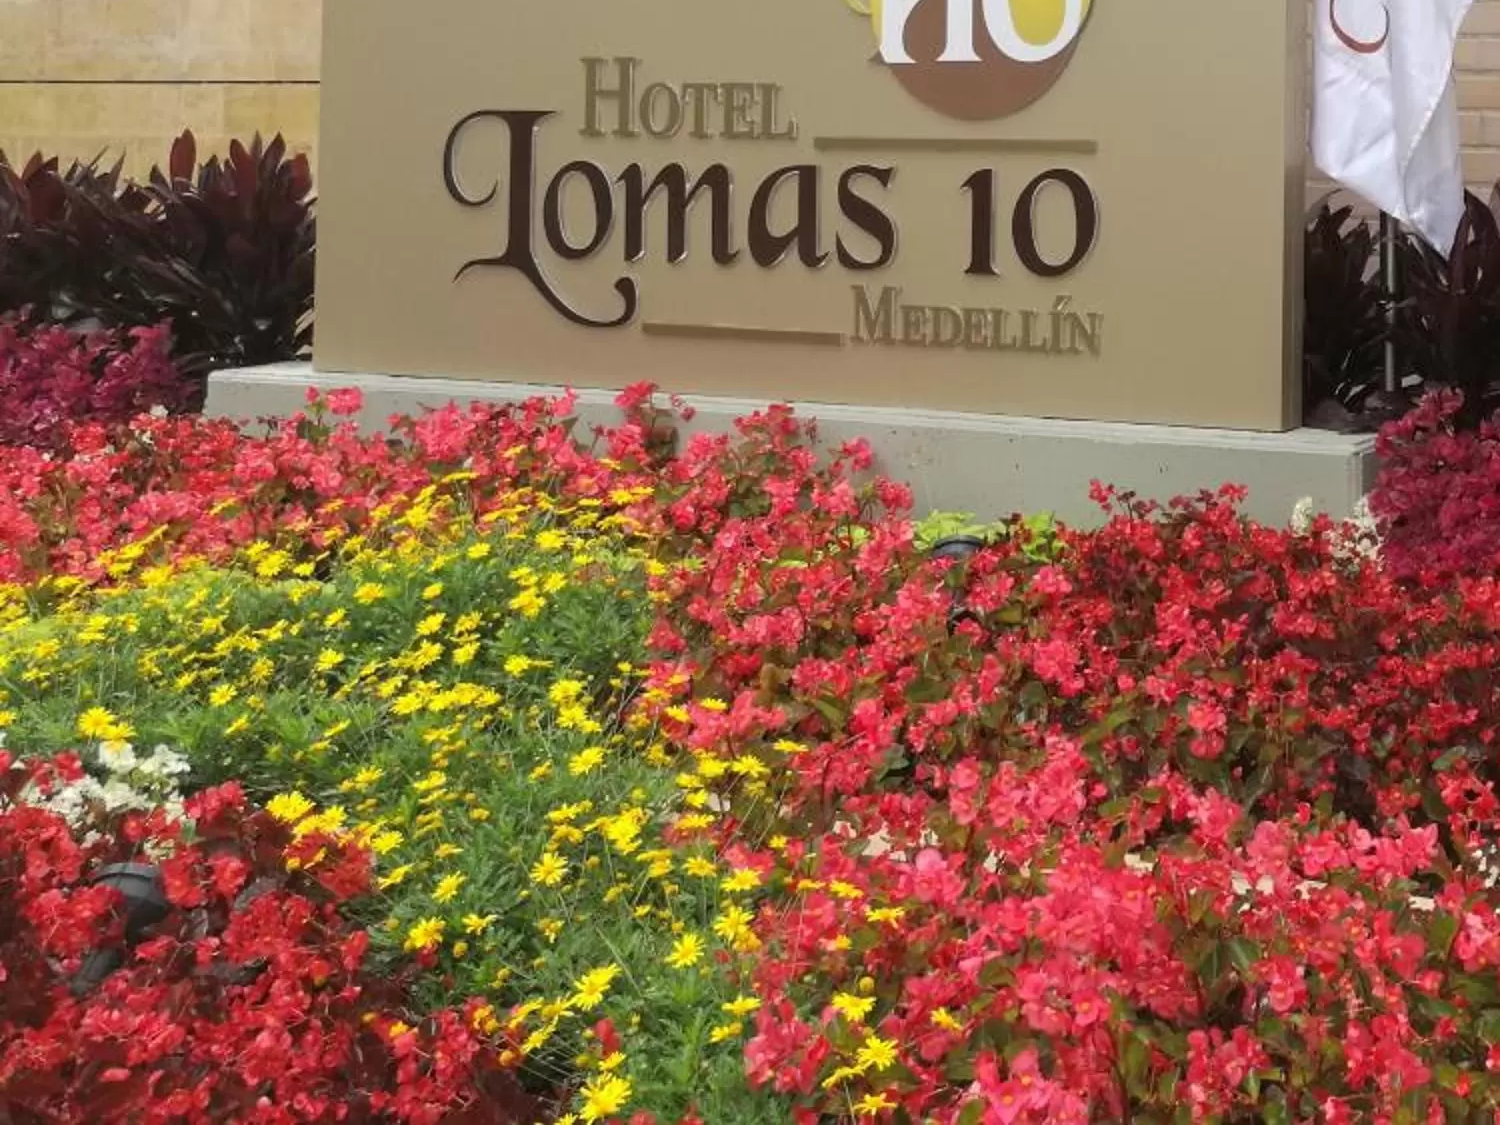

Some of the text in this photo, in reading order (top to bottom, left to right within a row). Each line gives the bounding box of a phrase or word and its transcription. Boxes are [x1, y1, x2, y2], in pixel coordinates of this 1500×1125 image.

[579, 56, 799, 140] HOTEL
[443, 108, 1100, 328] Lomas 10
